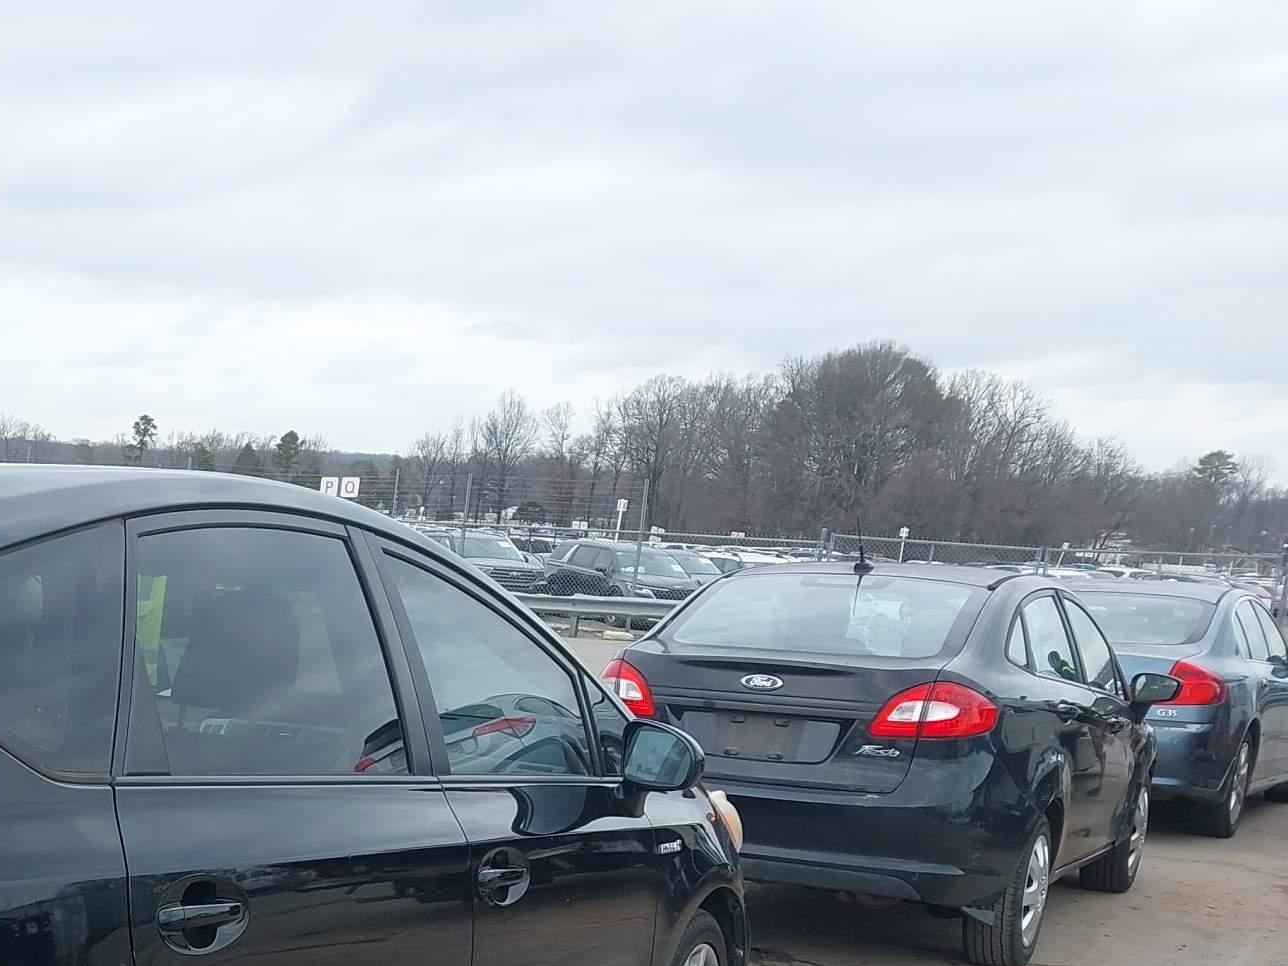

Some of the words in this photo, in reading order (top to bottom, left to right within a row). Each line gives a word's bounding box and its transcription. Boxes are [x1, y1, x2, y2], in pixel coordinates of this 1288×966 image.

[324, 480, 334, 494] P
[344, 480, 356, 494] Q
[1156, 708, 1178, 717] G35
